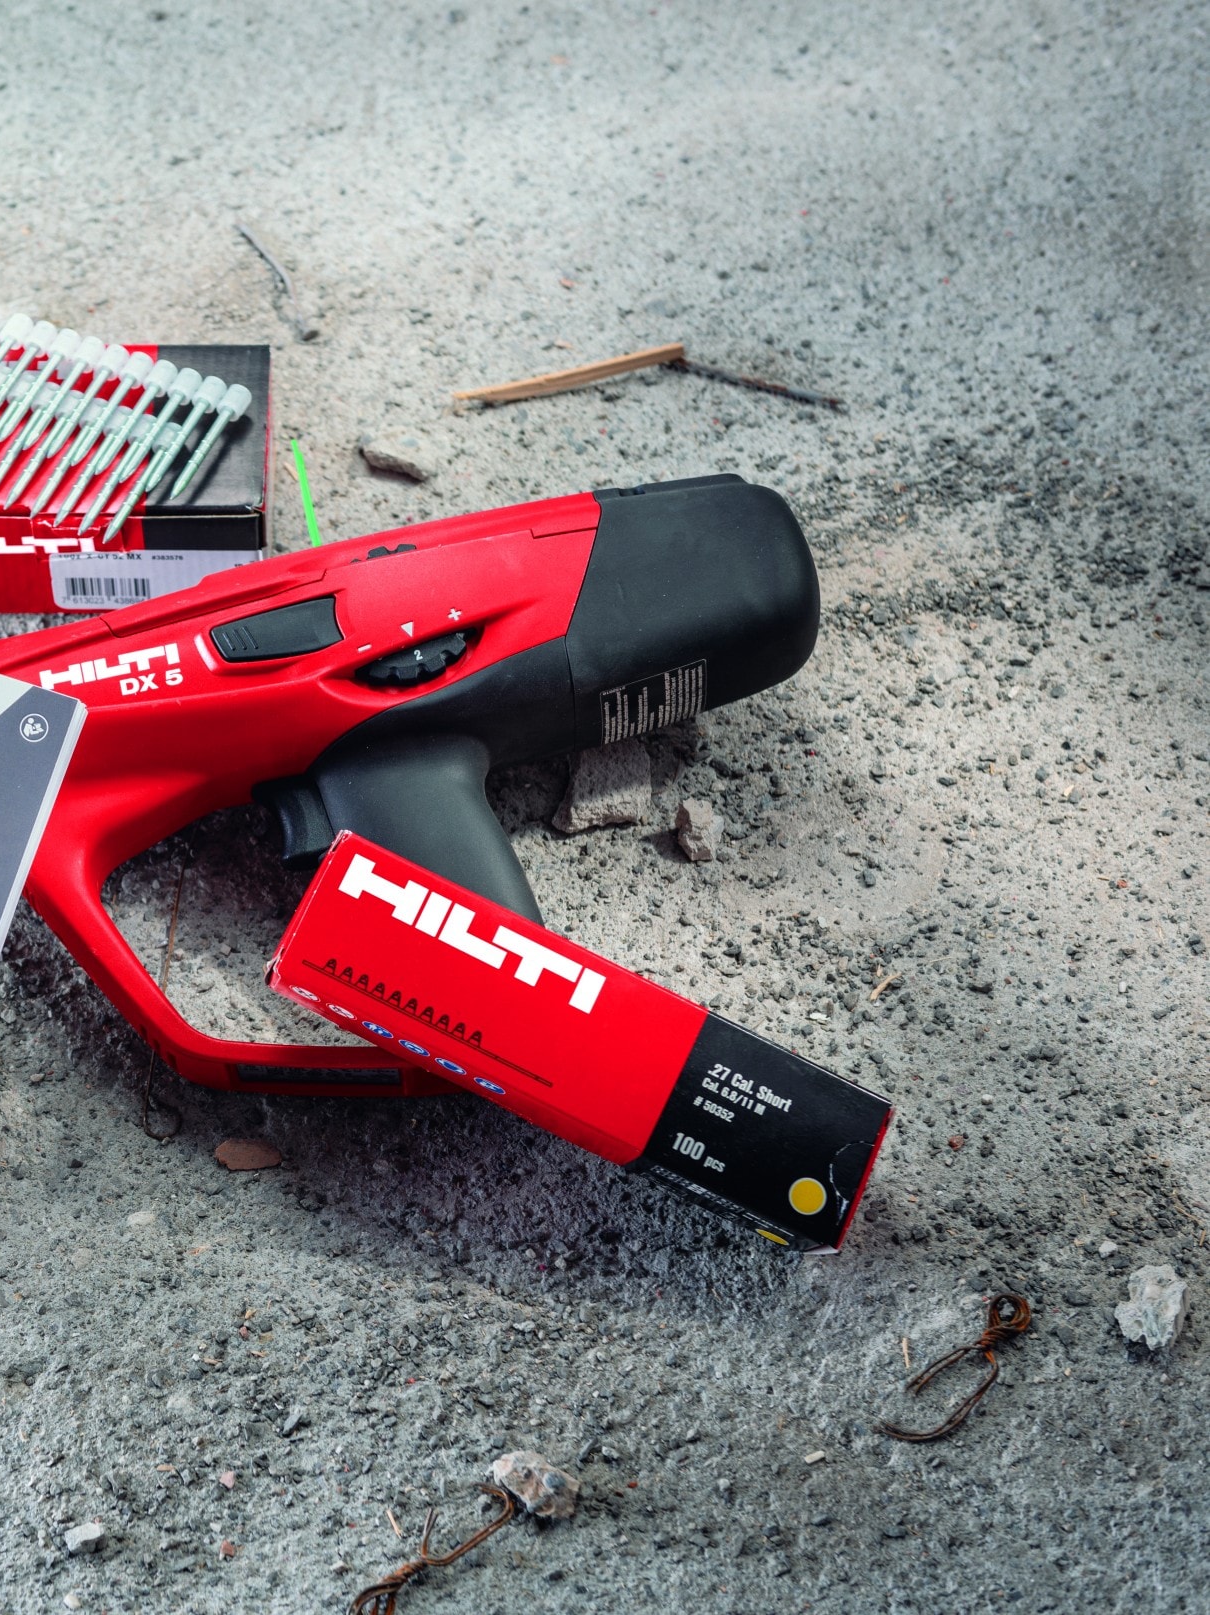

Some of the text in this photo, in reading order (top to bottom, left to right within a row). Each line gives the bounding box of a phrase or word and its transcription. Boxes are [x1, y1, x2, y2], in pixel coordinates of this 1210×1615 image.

[39, 643, 180, 690] HILTI
[413, 649, 424, 661] 2
[119, 668, 184, 696] DX 5
[338, 853, 606, 1014] HILTI
[701, 1077, 767, 1116] Cal. 6.8/11 M
[707, 1063, 793, 1113] .27 Cal. Short
[693, 1095, 735, 1123] # 50352
[672, 1132, 726, 1173] 100 pcs
